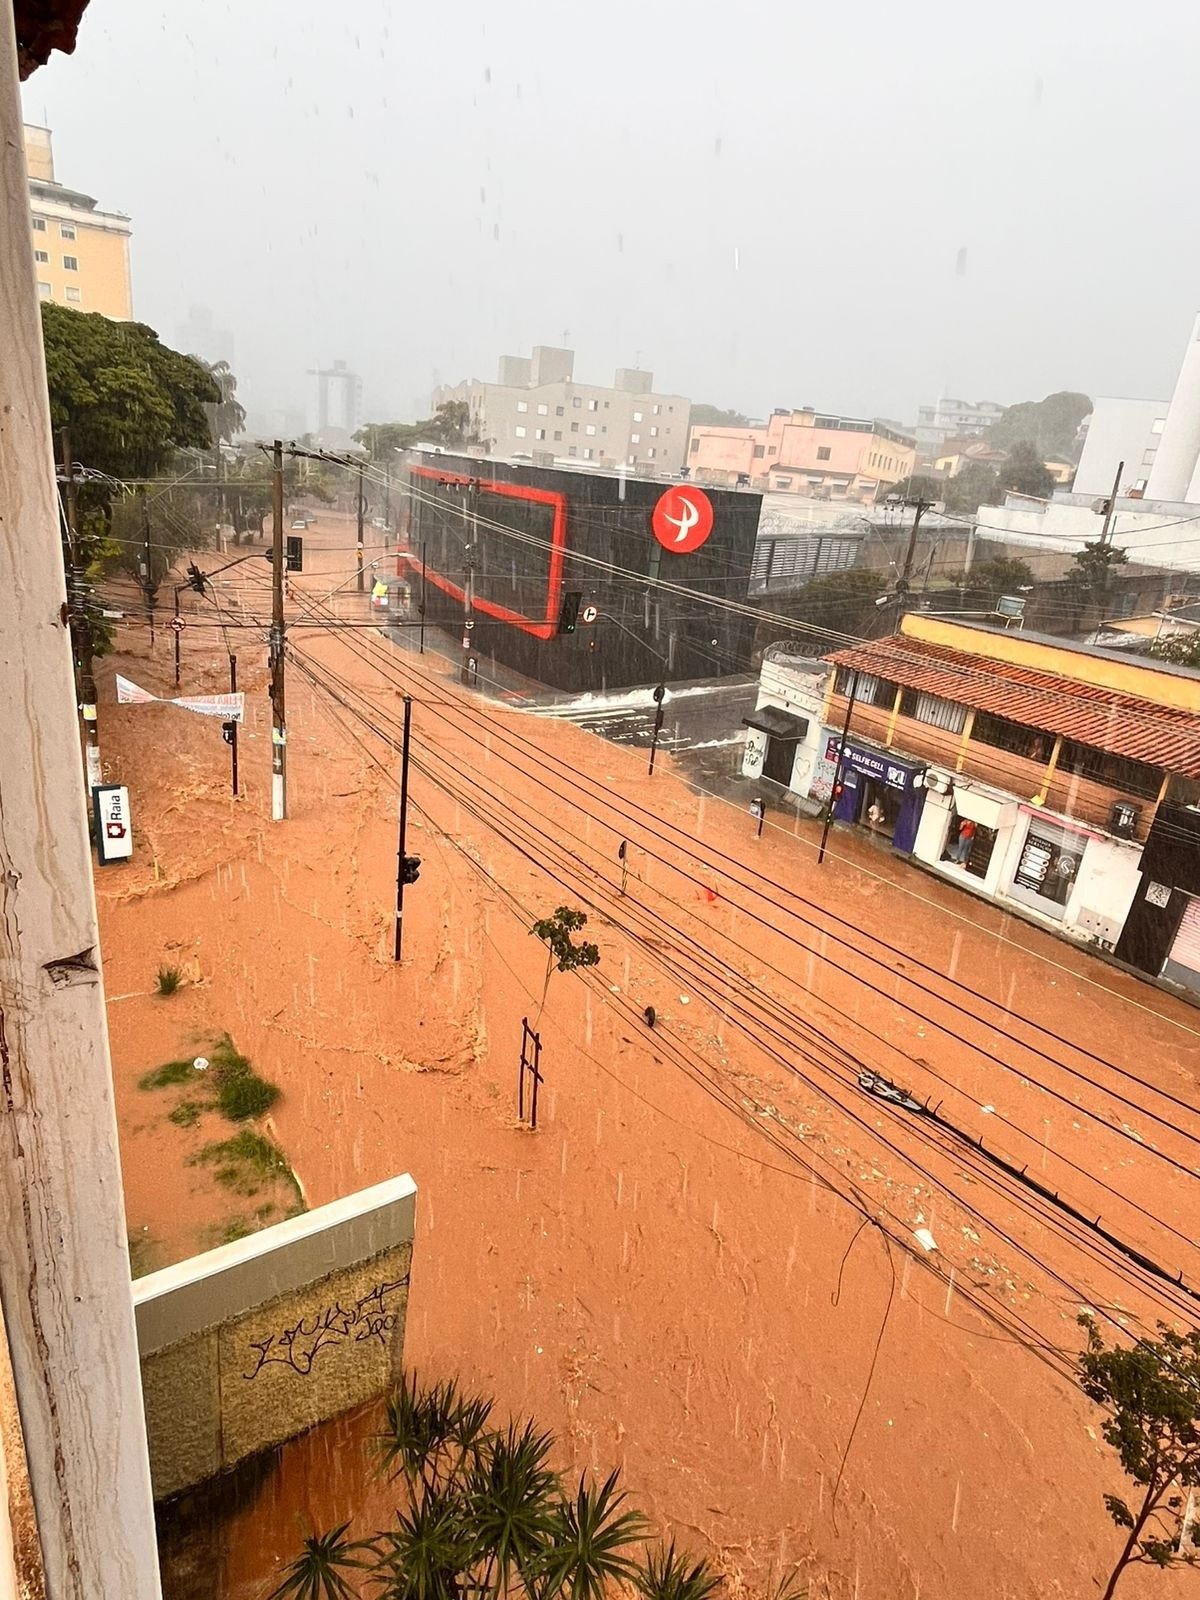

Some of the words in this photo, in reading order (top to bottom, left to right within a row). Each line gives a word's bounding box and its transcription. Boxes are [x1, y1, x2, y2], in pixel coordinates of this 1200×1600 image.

[851, 752, 870, 766] SELFIE
[870, 761, 884, 772] CELL
[110, 795, 122, 820] Raia
